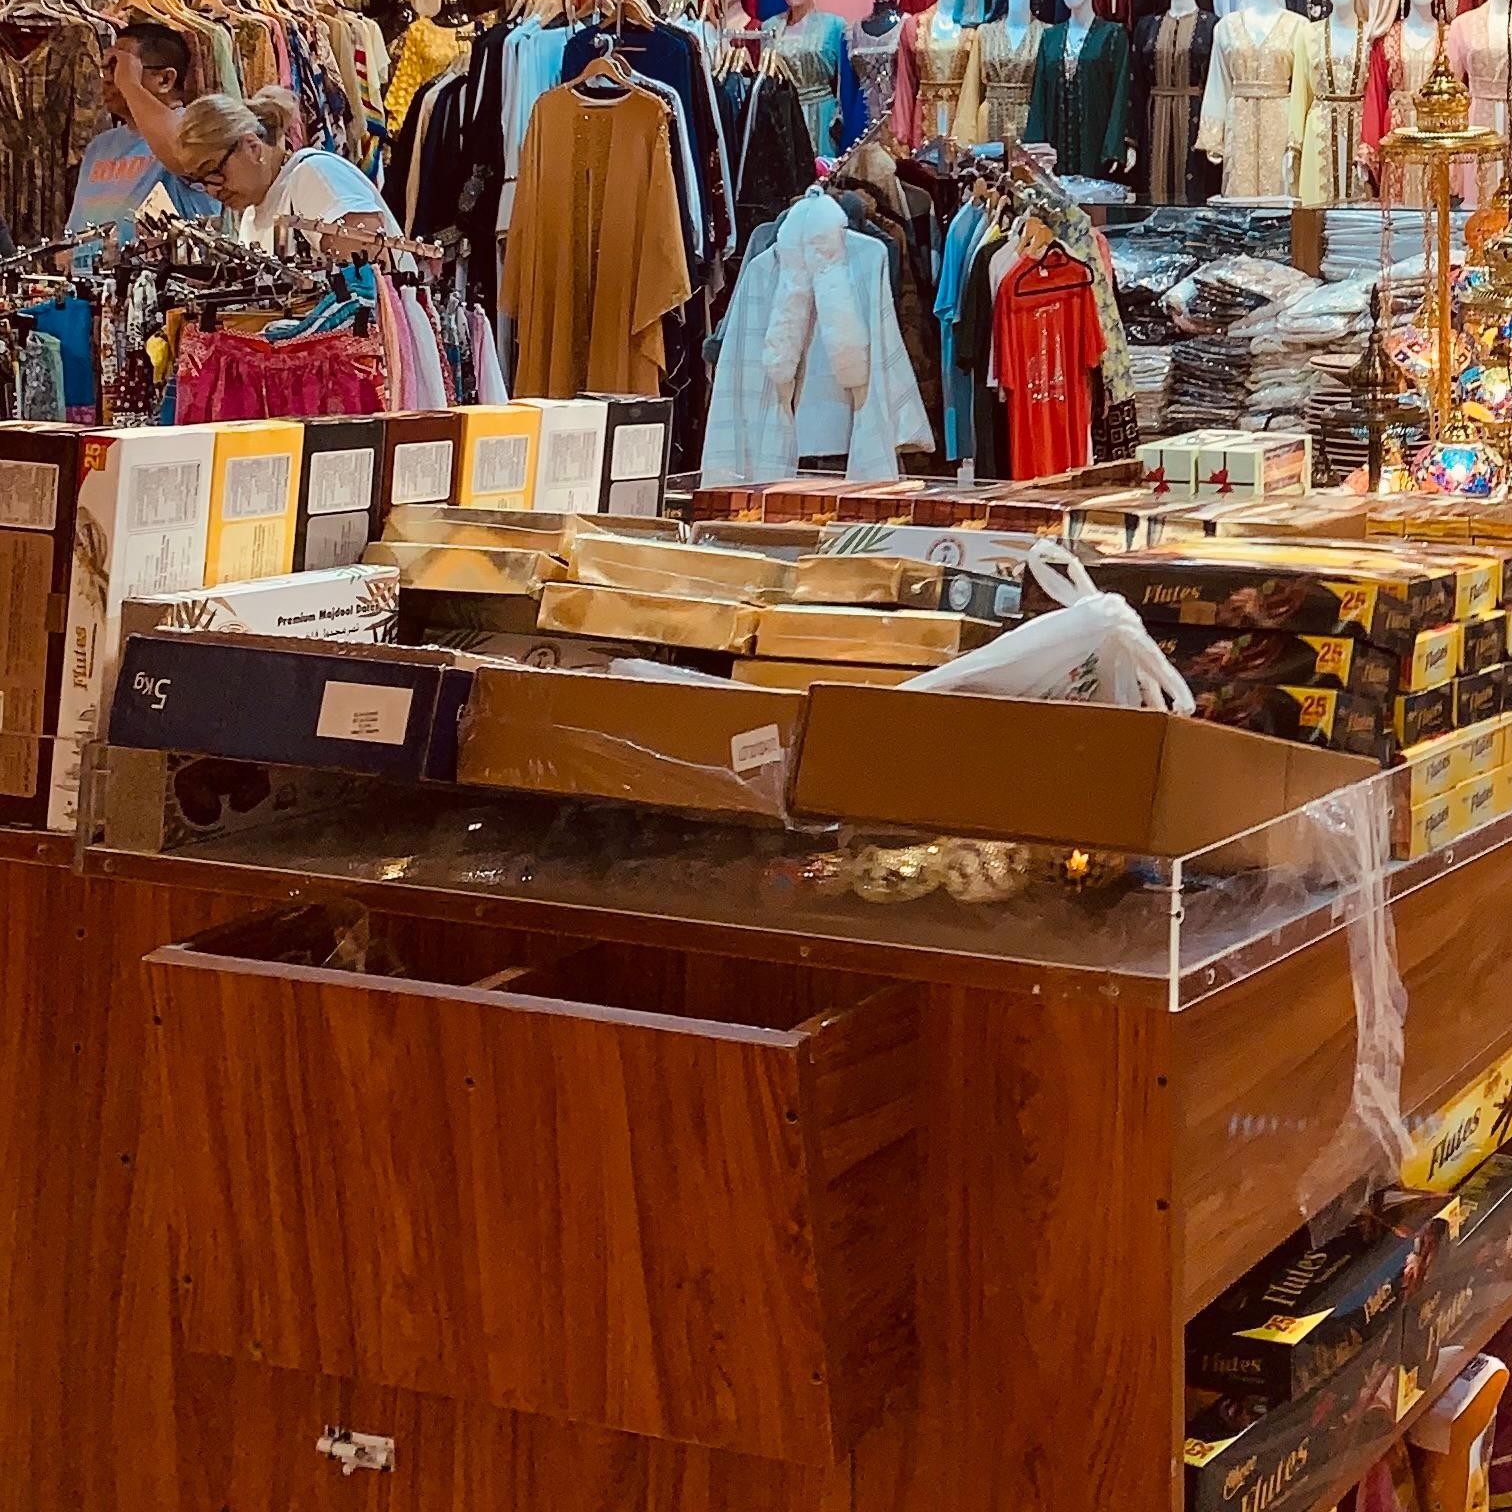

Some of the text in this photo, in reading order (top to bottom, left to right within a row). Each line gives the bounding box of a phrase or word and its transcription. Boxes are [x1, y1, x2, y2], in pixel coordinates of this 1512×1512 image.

[1142, 584, 1202, 605] Flutes
[1341, 590, 1367, 609] 25
[277, 612, 316, 627] Premium
[319, 605, 354, 620] Majdool
[1318, 642, 1344, 665] 25
[1301, 695, 1328, 718] 25
[1427, 1106, 1482, 1182] Flutes
[1262, 1250, 1328, 1307] Flutes
